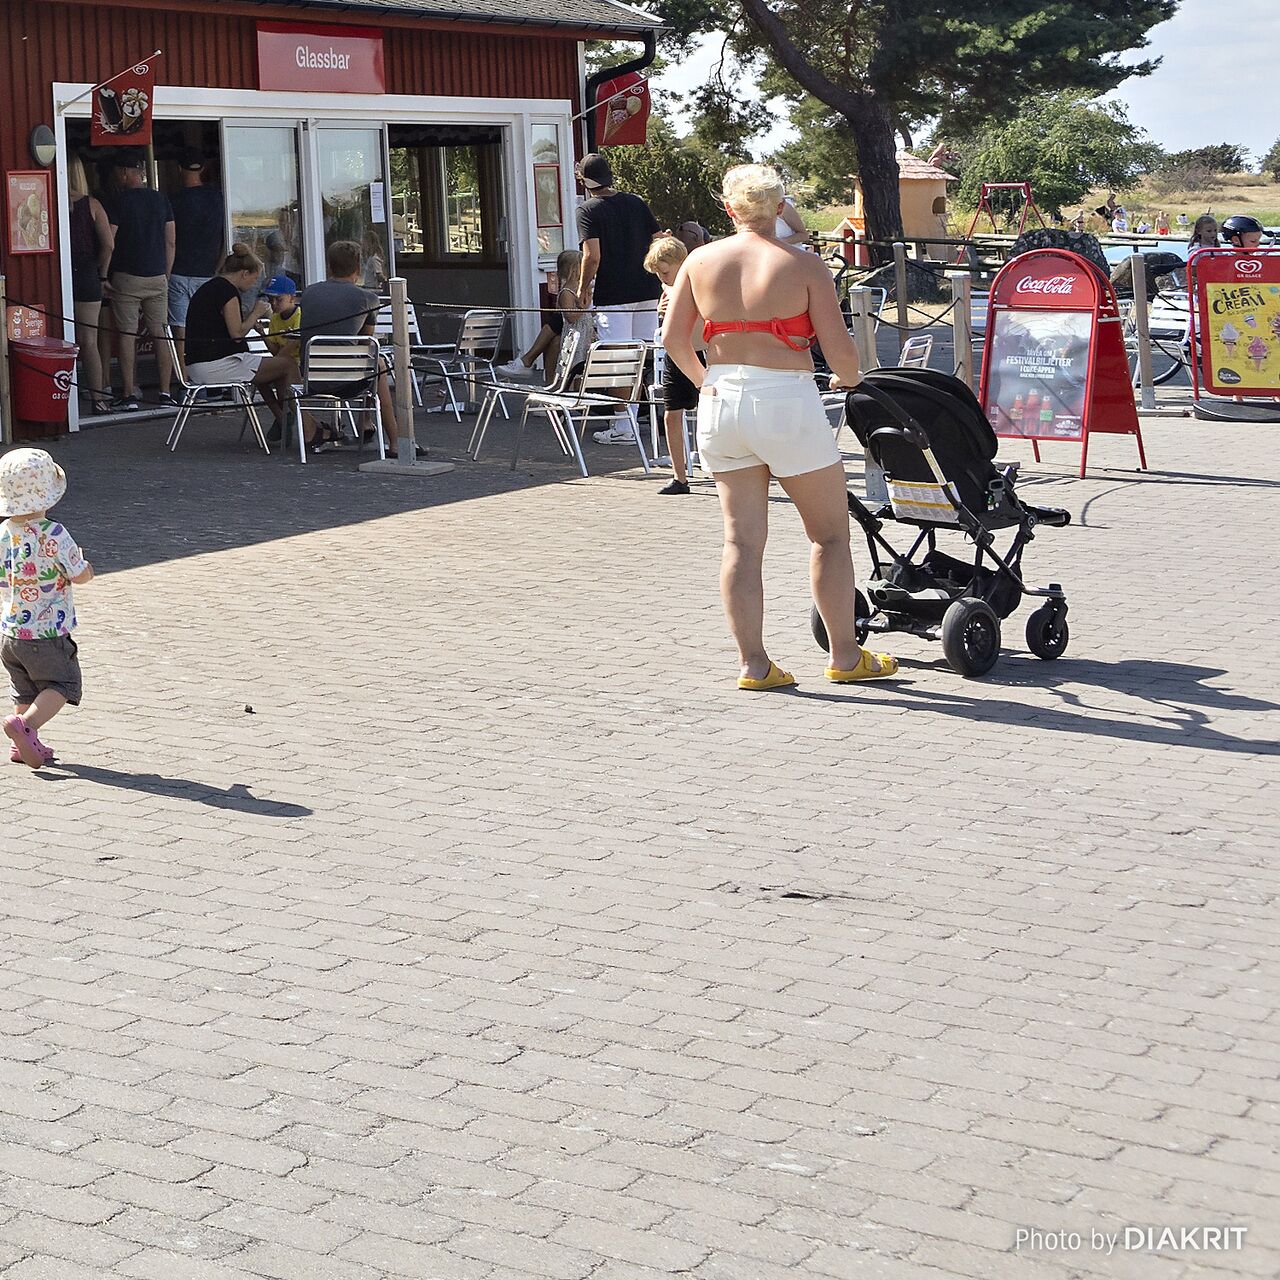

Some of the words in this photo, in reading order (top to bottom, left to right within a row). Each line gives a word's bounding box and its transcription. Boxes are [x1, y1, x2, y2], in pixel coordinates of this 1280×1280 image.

[295, 46, 351, 70] Glassbar
[1016, 275, 1077, 295] Coca-Cola
[1212, 291, 1266, 315] CREAM
